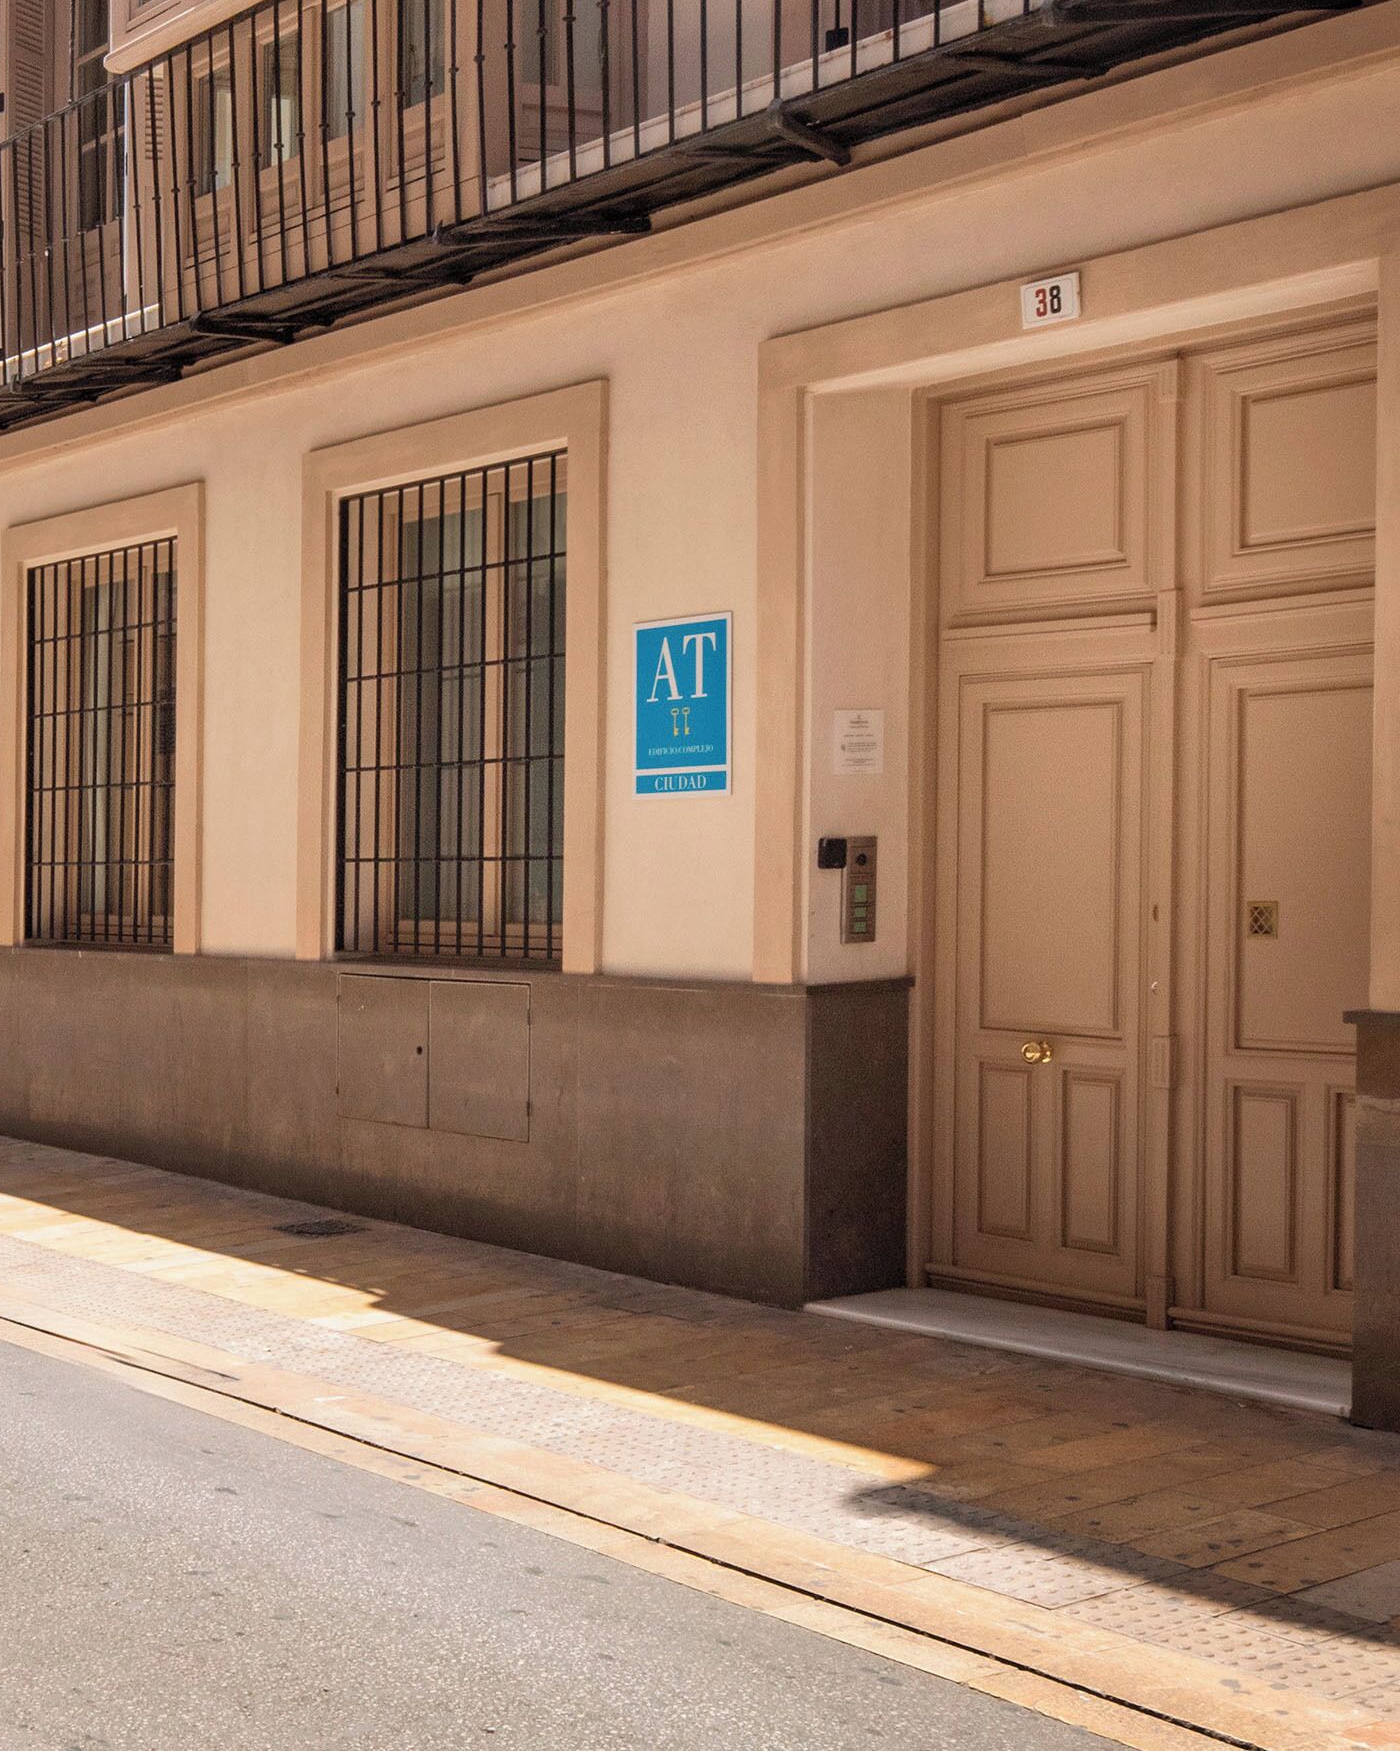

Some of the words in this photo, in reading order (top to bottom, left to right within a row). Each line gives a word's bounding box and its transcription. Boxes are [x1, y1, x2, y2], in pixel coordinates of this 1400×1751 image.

[1035, 285, 1061, 317] 38
[647, 632, 717, 702] AT
[654, 775, 706, 791] CIUDAD
